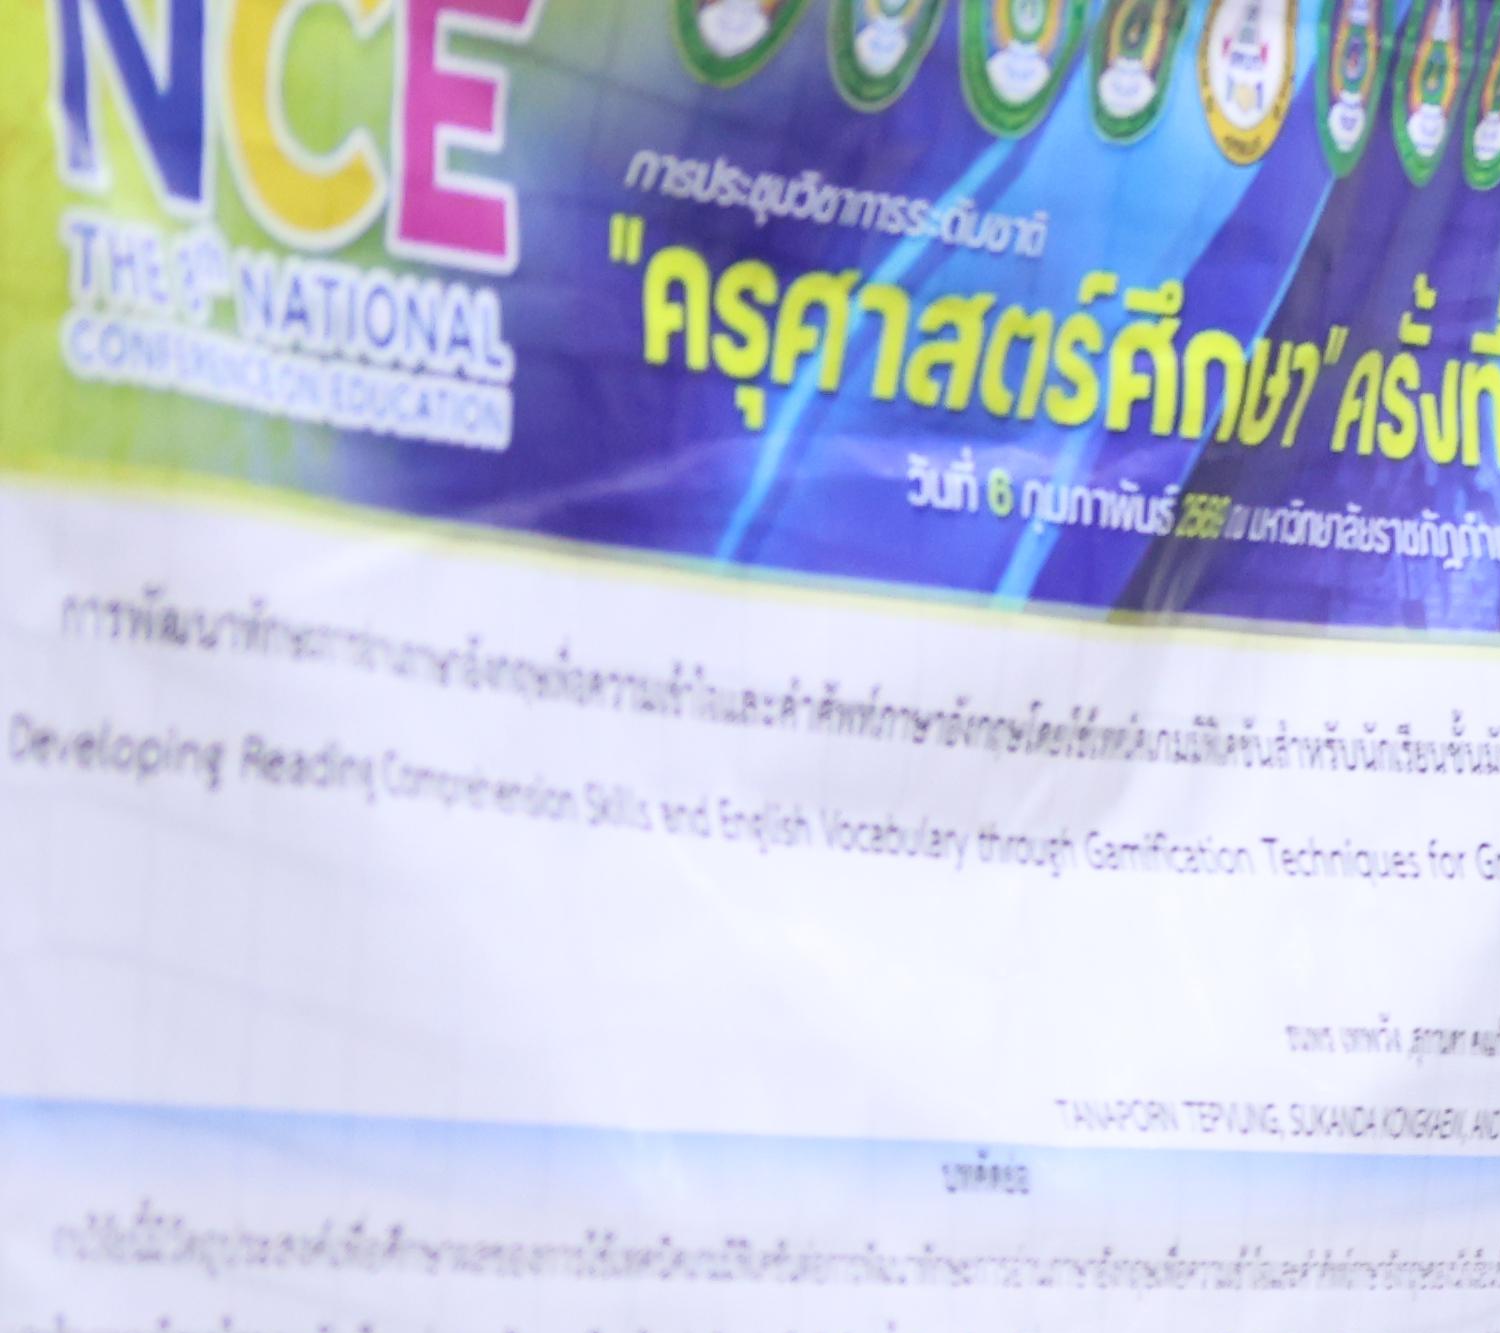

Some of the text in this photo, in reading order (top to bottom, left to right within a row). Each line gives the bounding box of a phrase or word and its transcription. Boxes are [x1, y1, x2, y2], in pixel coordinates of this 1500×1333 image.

[53, 0, 540, 272] NCE
[70, 222, 168, 308] THE
[238, 258, 510, 380] NATIONAL
[906, 447, 981, 514] วันที่
[987, 467, 1014, 517] 6
[9, 712, 223, 791] Developing
[240, 733, 376, 805] Reading
[382, 748, 574, 822] Comprehension
[585, 779, 652, 831] Skills
[660, 795, 711, 840] and
[719, 798, 810, 857] English
[821, 806, 968, 871] Vocabulary
[978, 824, 1075, 879] through
[1086, 829, 1254, 875] Gamification
[1261, 836, 1421, 888] Techniques
[1427, 838, 1466, 880] for
